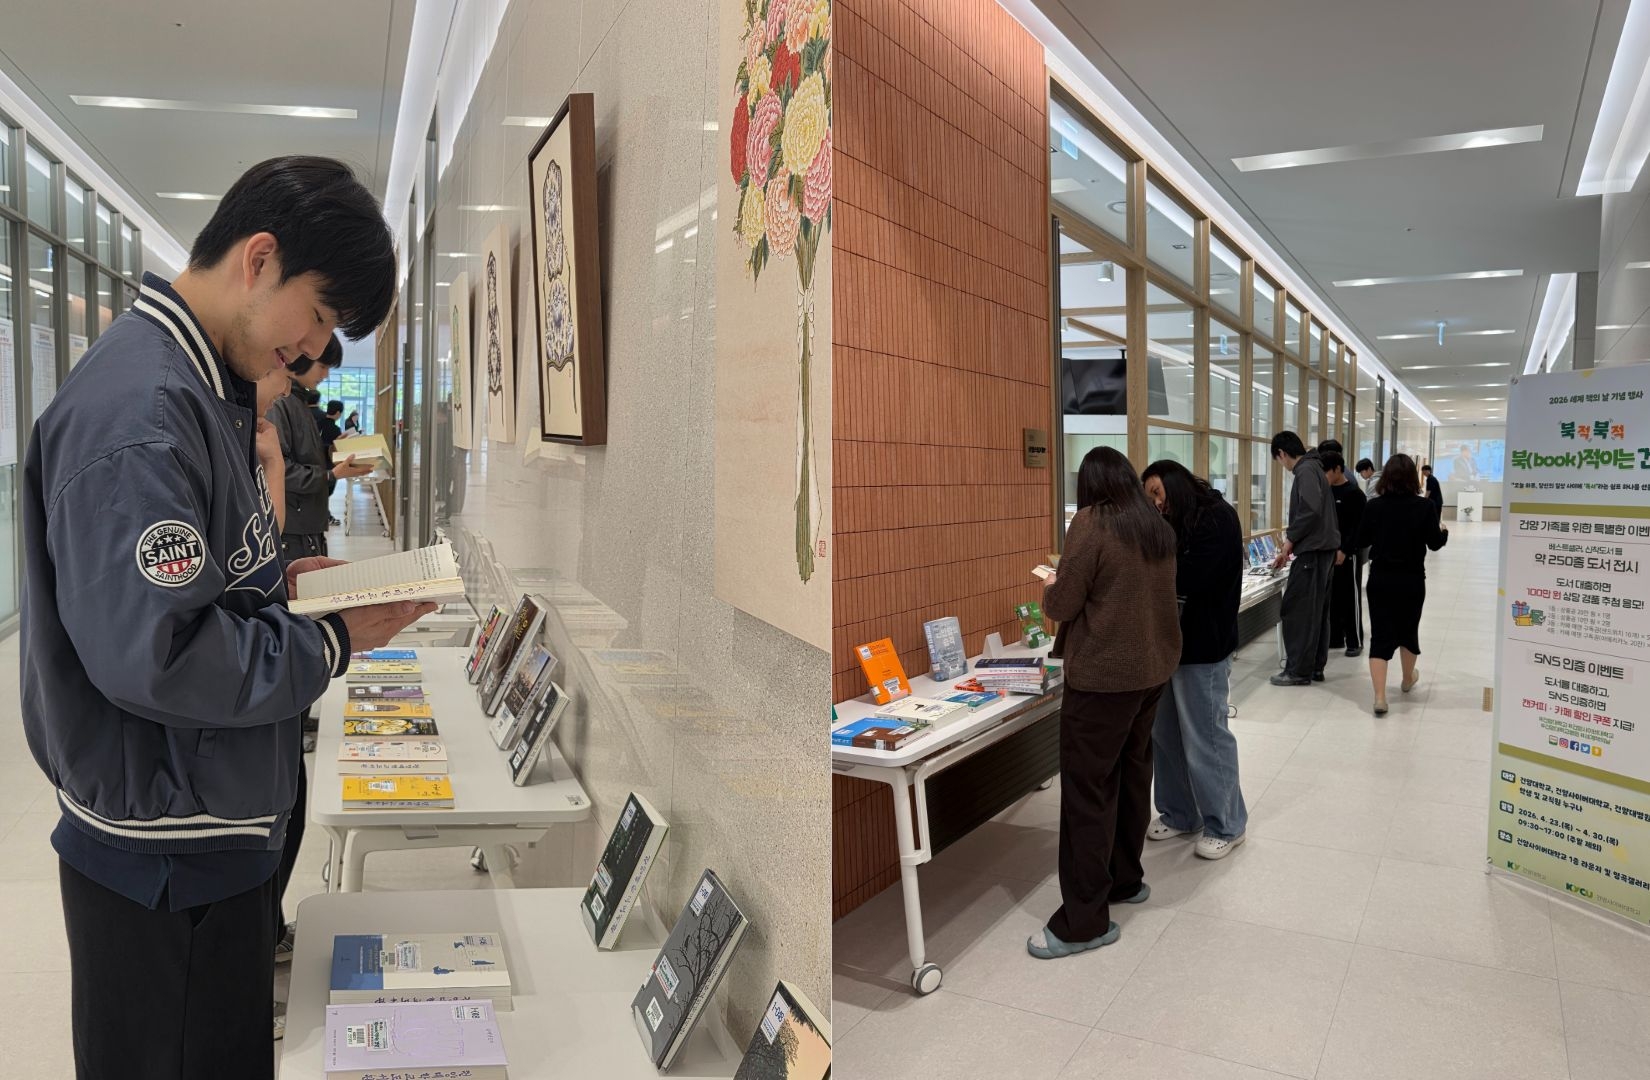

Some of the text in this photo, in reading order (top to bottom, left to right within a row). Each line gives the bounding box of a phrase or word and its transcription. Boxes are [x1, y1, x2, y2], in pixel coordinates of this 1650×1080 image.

[1549, 389, 1643, 405] 2026 세계 책의 날 기념 행사
[1512, 448, 1635, 469] 북(book)적이는
[145, 526, 193, 547] THE GENUINE
[1520, 520, 1539, 530] 건양
[1541, 521, 1570, 532] 가족을
[1572, 522, 1592, 534] 위한
[1594, 523, 1626, 535] 특별한
[145, 542, 197, 565] SAINT
[1585, 546, 1614, 555] 신착도서
[155, 563, 198, 582] SAINTHOOD
[1535, 553, 1639, 574] 약 250종 도서 전시
[1556, 577, 1611, 593] 도서 대출하면
[1527, 587, 1551, 599] 100만
[1552, 590, 1562, 600] 원
[1563, 591, 1580, 602] 상당
[1582, 594, 1600, 605] 경품
[1601, 596, 1620, 607] 추첨
[1534, 653, 1624, 679] SNS 인증 이벤트
[1544, 676, 1610, 698] 도서를 대출하고,
[1548, 691, 1606, 712] SNS 인증하면
[1522, 698, 1547, 712] 캔커피
[1554, 705, 1572, 718] 카페
[1574, 709, 1591, 722] 할인
[1593, 713, 1612, 727] 쿠폰
[1613, 718, 1635, 732] 지급!
[1520, 777, 1554, 793] 건양대학교,
[1555, 787, 1612, 811] 건양사이버대학교,
[1562, 800, 1583, 812] 누구나
[1518, 808, 1539, 820] 2026.
[1540, 815, 1548, 824] 4.
[1583, 829, 1591, 838] 4.
[1567, 834, 1583, 847] (주말
[1517, 838, 1567, 861] 건양사이버대학교
[1569, 856, 1579, 866] 1층
[1581, 860, 1602, 874] 라운지
[1565, 882, 1594, 898] KYCU
